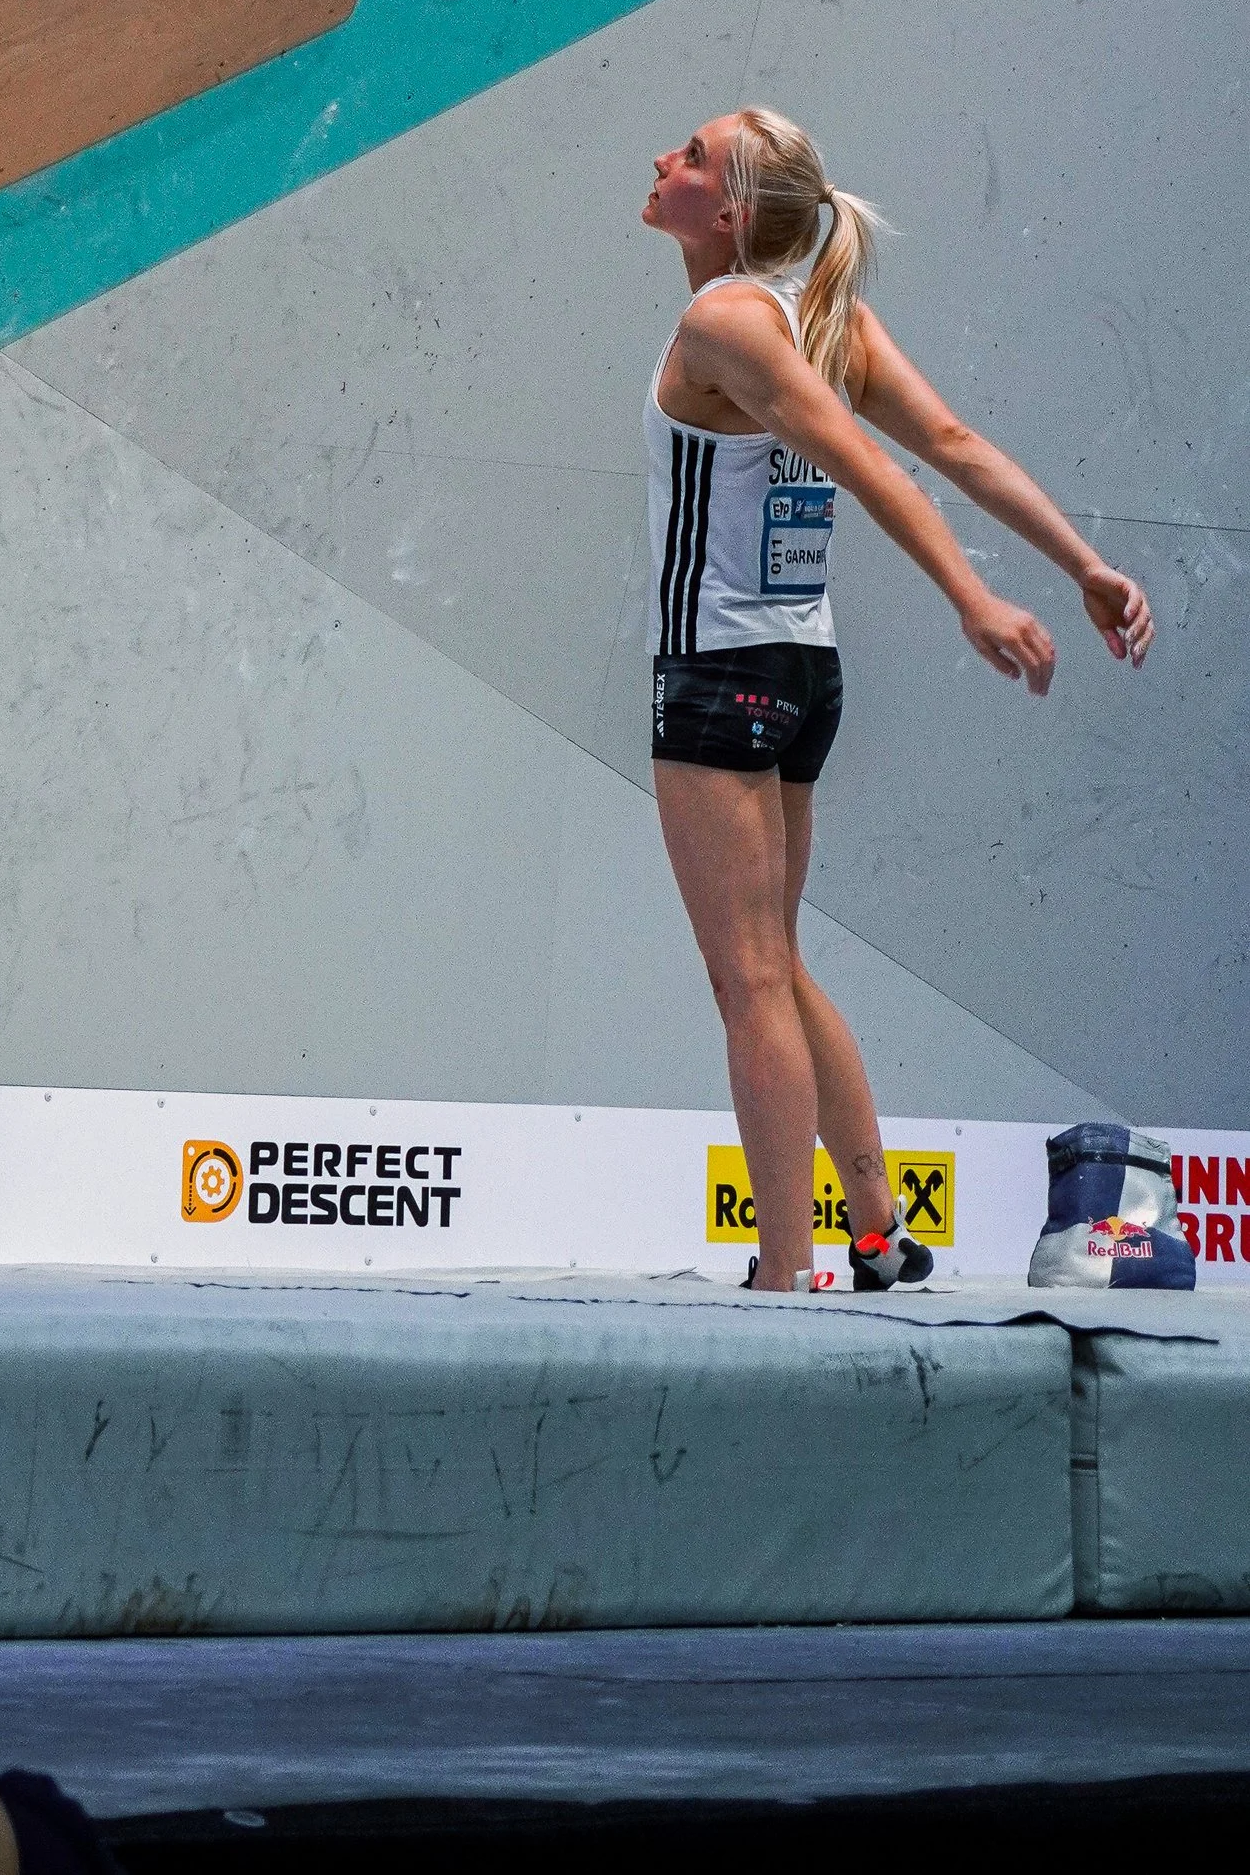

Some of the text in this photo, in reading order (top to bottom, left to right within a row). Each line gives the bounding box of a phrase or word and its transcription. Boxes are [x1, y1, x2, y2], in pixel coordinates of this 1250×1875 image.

[770, 539, 783, 575] 011
[655, 673, 666, 719] TERREX
[776, 699, 800, 716] PRVA
[250, 1141, 462, 1180] PERFECT
[248, 1182, 462, 1227] DESCENT
[1088, 1241, 1153, 1258] Red Bull
